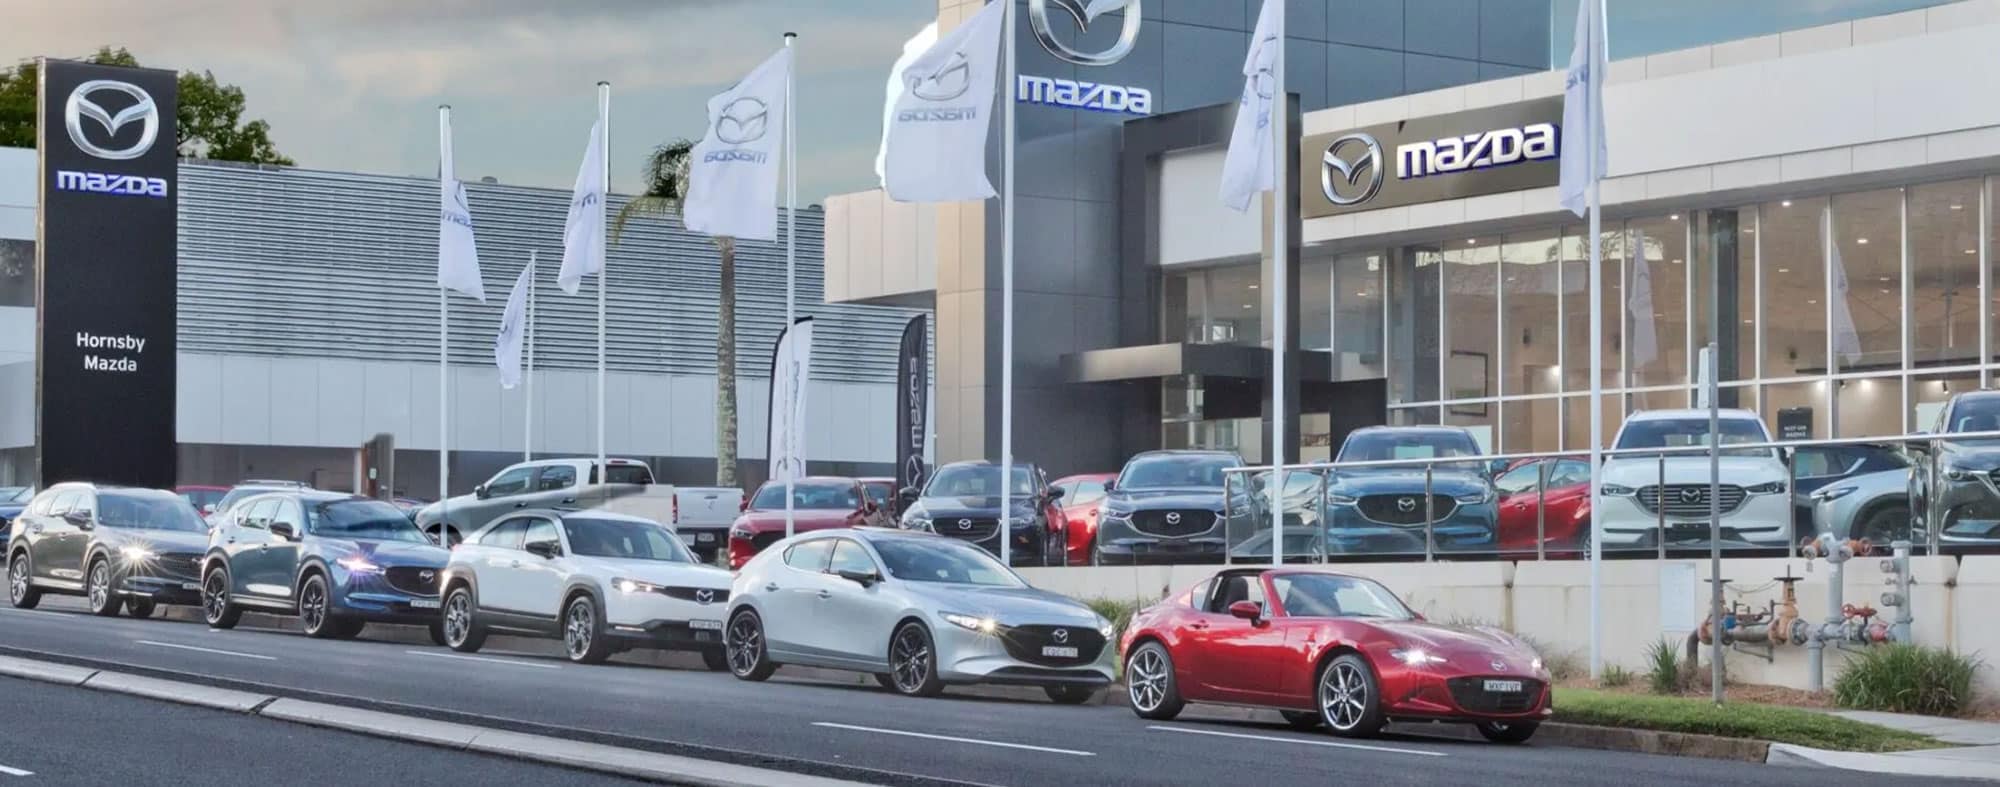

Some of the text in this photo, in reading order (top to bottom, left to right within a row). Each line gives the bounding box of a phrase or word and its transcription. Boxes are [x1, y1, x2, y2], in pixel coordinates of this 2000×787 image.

[1018, 74, 1152, 115] mazda
[1397, 123, 1560, 179] mazda
[57, 170, 168, 197] mazda
[76, 332, 145, 353] Hornsby
[84, 355, 137, 372] Mazda
